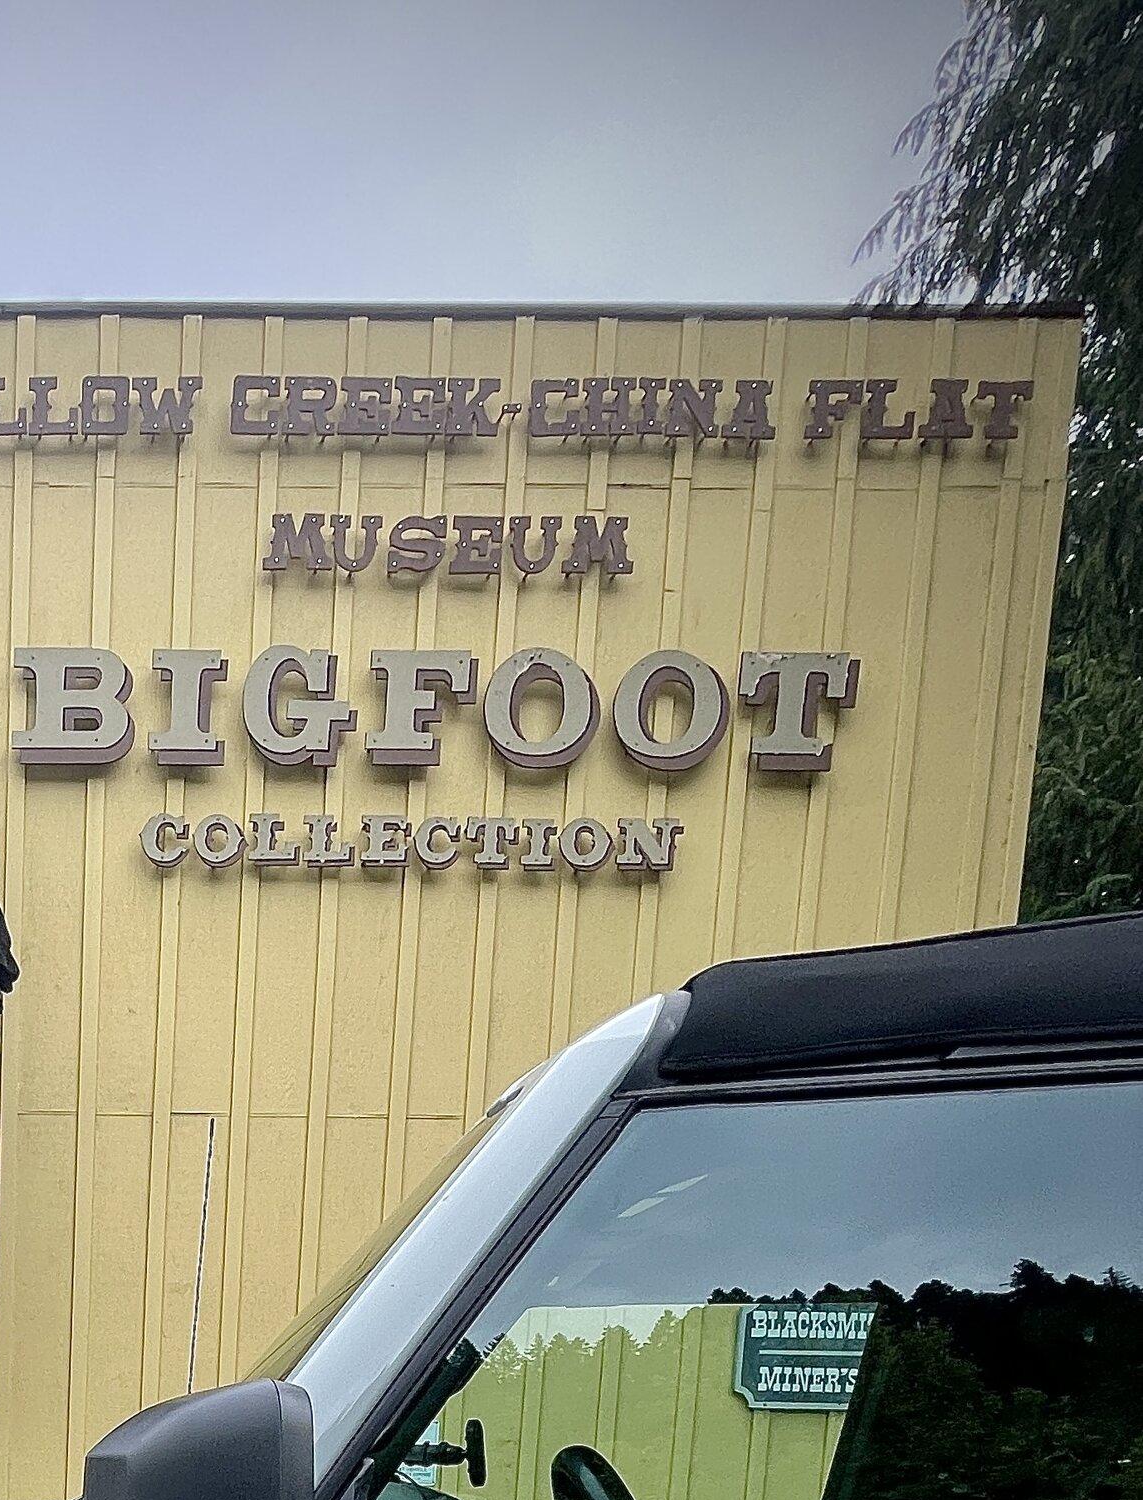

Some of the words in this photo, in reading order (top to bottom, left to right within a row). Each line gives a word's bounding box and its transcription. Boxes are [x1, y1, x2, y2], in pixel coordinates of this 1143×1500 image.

[230, 375, 776, 440] CREEK-CHINA
[804, 378, 1035, 440] FLAT
[263, 513, 634, 575] MUSEUM
[12, 645, 860, 772] BIGFOOT
[139, 812, 683, 872] COLLECTION
[757, 1365, 859, 1394] MINER'S
